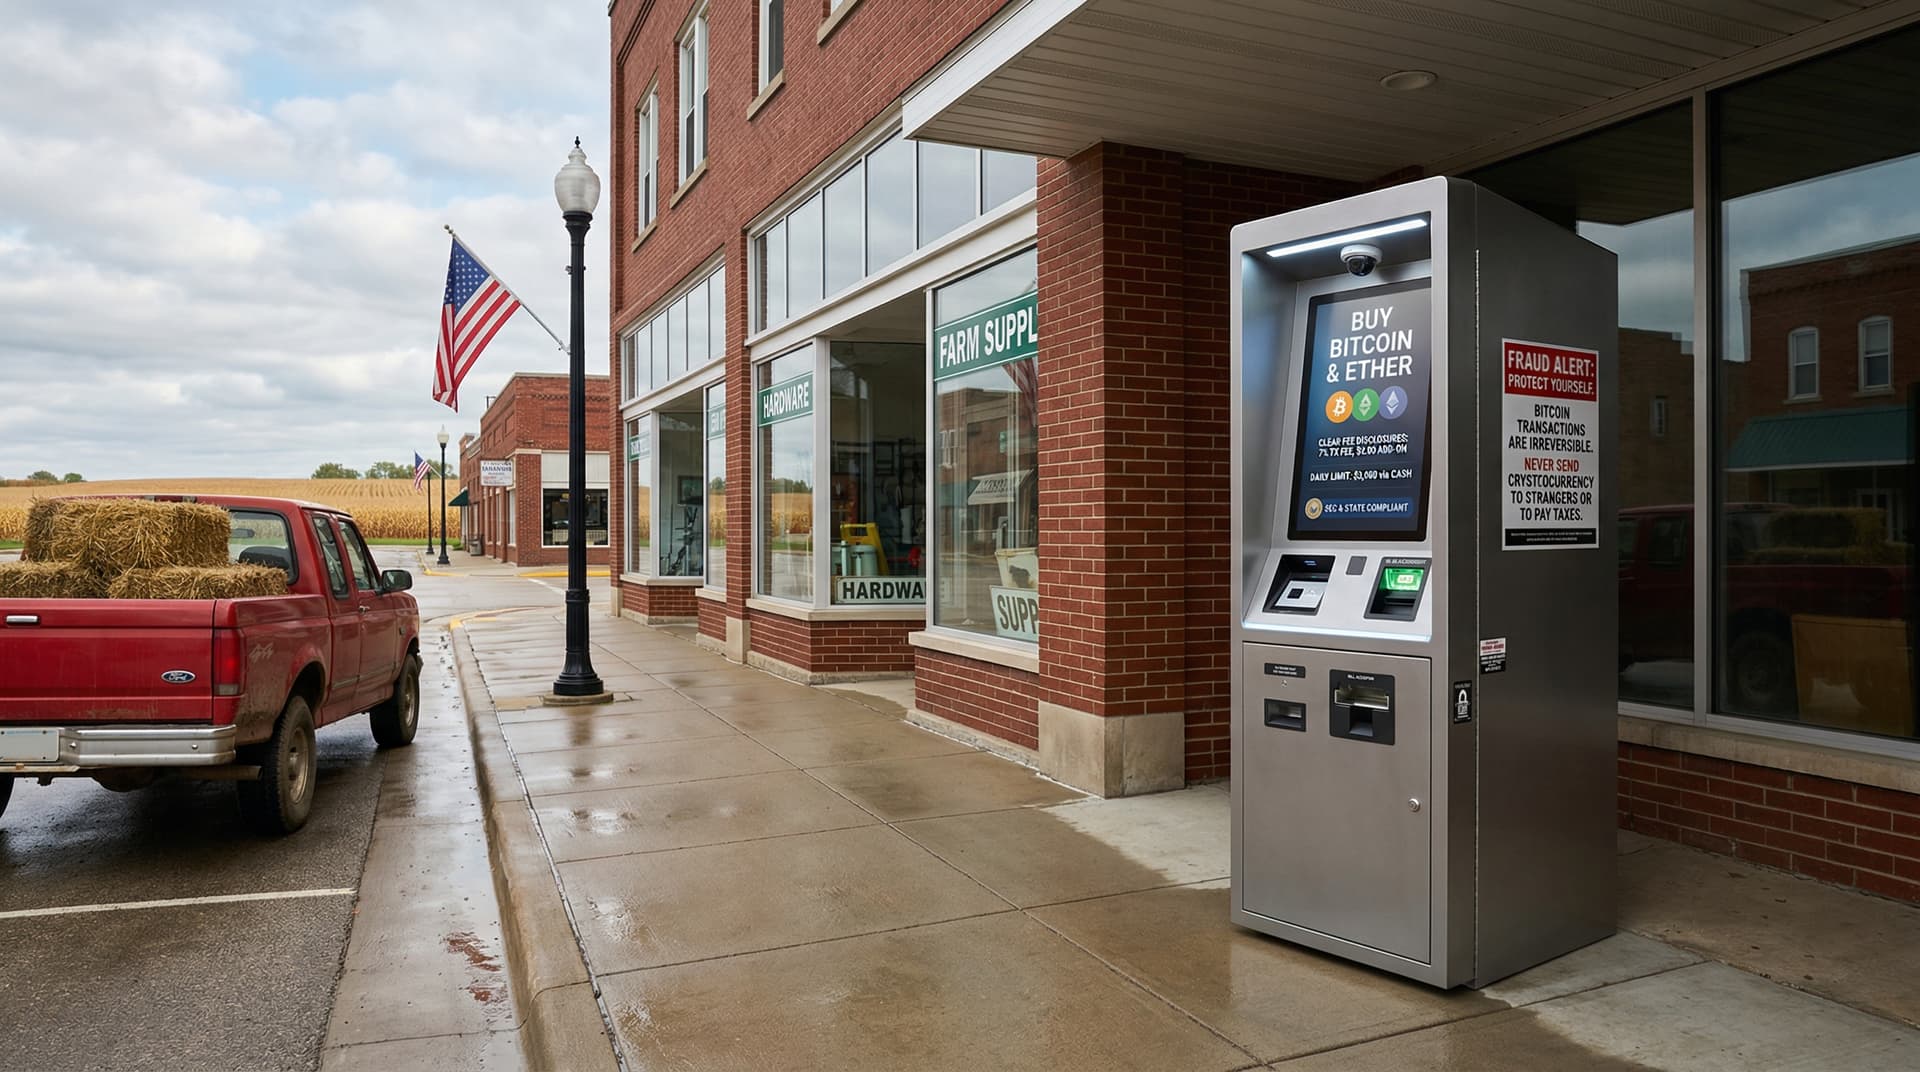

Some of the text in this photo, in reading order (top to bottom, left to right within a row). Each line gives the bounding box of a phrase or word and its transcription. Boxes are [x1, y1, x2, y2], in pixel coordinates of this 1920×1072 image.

[1351, 306, 1393, 331] BUY
[940, 304, 1038, 369] FARM SUPPL
[1330, 329, 1412, 358] BITCOIN
[1326, 355, 1413, 383] & ETHER
[1508, 350, 1594, 377] FRAUD ALERT:
[1508, 374, 1595, 395] PROTECT YOURSELF.
[763, 381, 809, 419] HARDWARE
[1534, 404, 1570, 419] BITCOIN
[1517, 419, 1586, 436] TRANSACTIONS
[1318, 437, 1341, 447] CLEAR
[1508, 435, 1593, 453] ARE IRREVERSIBLE.
[1524, 457, 1580, 472] NEVER SEND
[1310, 472, 1329, 482] DAILY
[1330, 471, 1352, 481] LIMIT:
[1391, 469, 1412, 479] CASH
[1511, 490, 1592, 504] TO STRANGERS OR
[1345, 503, 1366, 513] STATE
[1366, 502, 1409, 513] COMPLIANT
[1520, 508, 1583, 521] TO PAY TAXES.
[842, 581, 926, 599] HARDWA
